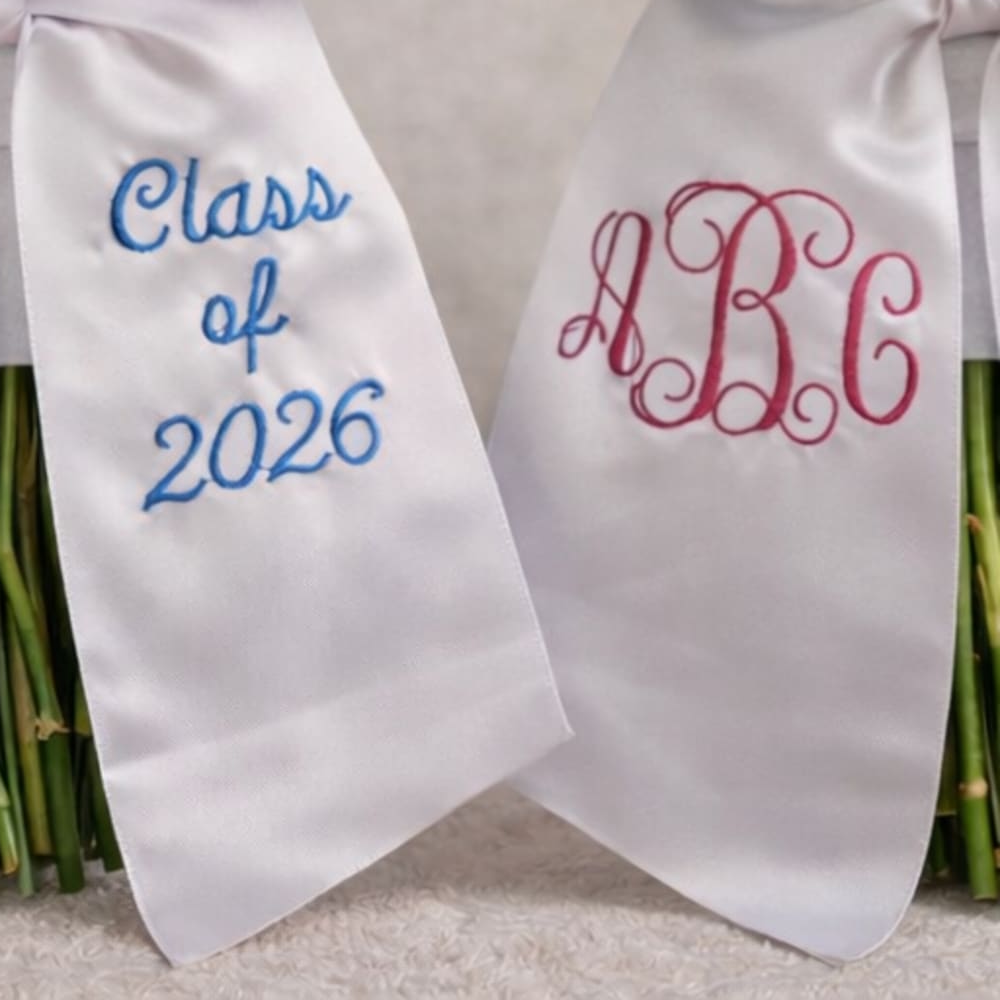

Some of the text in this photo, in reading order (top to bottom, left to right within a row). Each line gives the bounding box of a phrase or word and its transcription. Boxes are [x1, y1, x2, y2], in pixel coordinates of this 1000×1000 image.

[109, 157, 352, 254] Class
[201, 256, 290, 374] of
[557, 180, 923, 446] ABC
[141, 377, 384, 511] 2026
